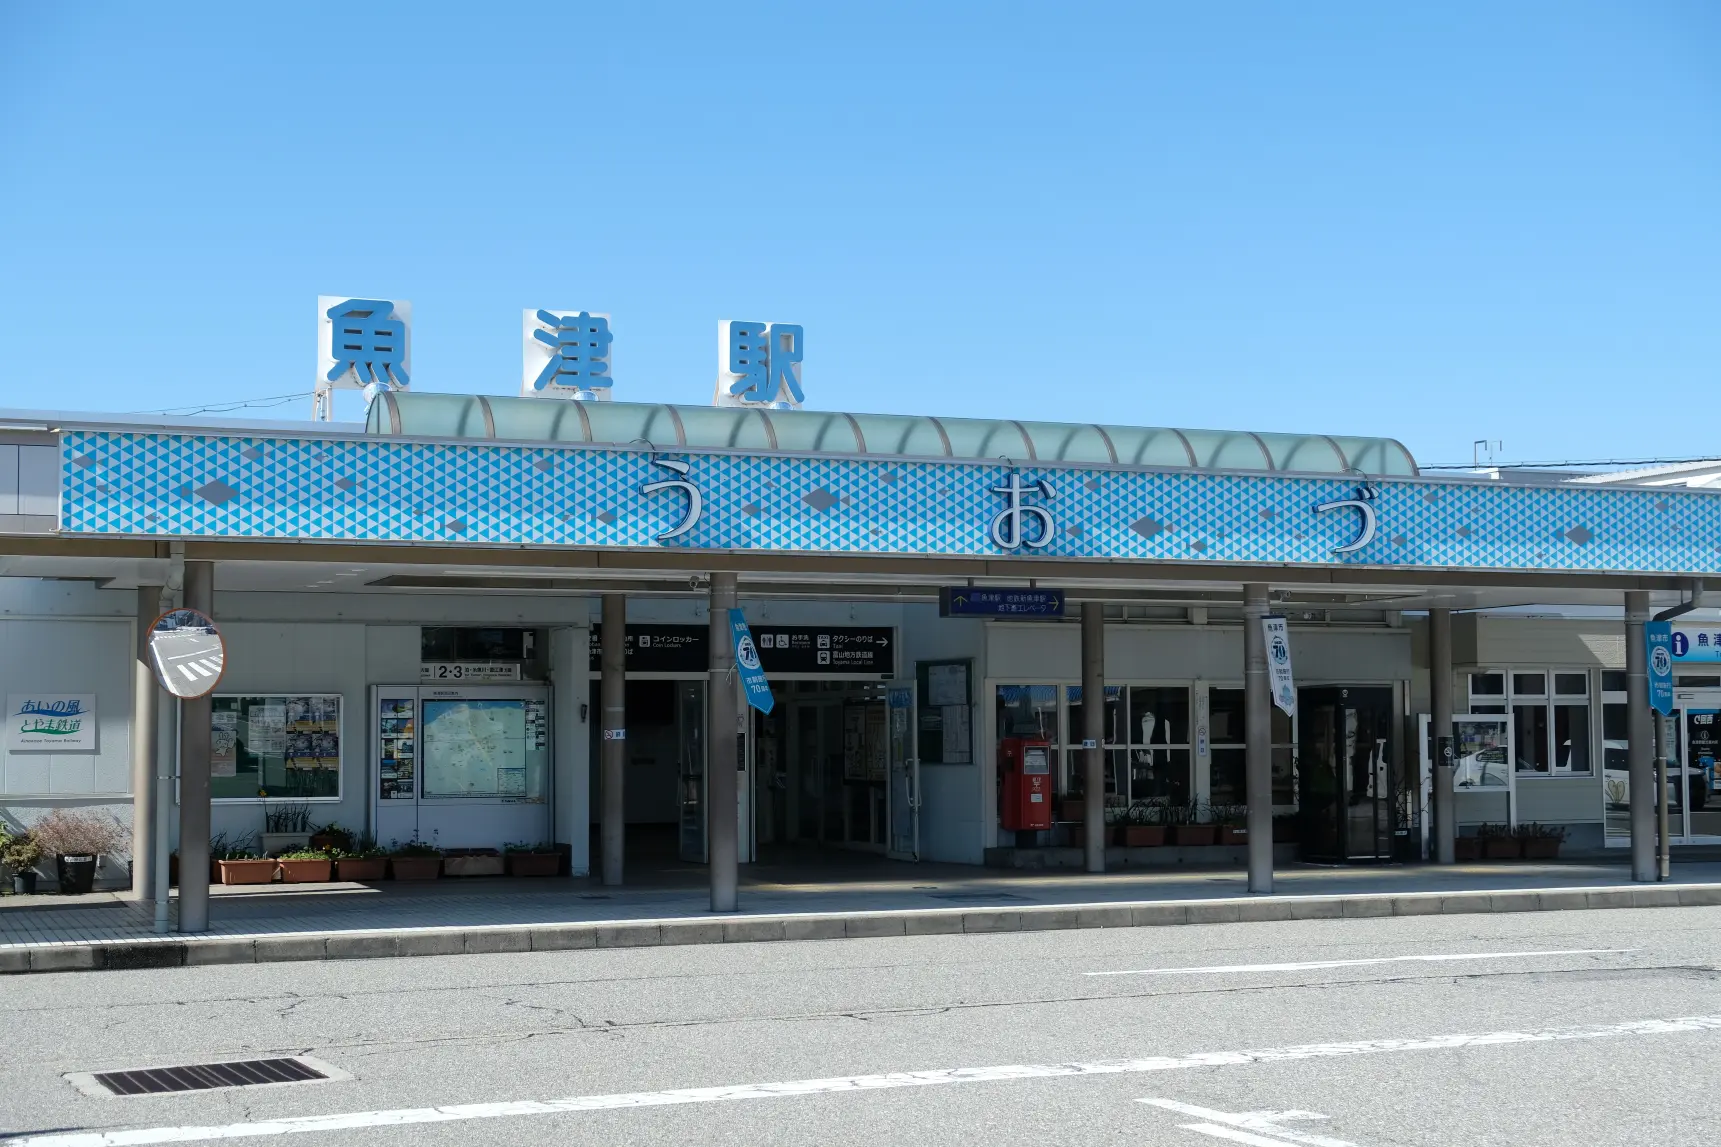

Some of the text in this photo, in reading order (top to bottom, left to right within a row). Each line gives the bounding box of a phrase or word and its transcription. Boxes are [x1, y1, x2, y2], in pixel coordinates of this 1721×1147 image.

[327, 299, 806, 404] 魚津駅
[653, 635, 699, 643] コインロッカー
[832, 635, 874, 643] タクシーのりば
[21, 699, 83, 715] あいの風
[20, 718, 83, 732] とやま鉄道
